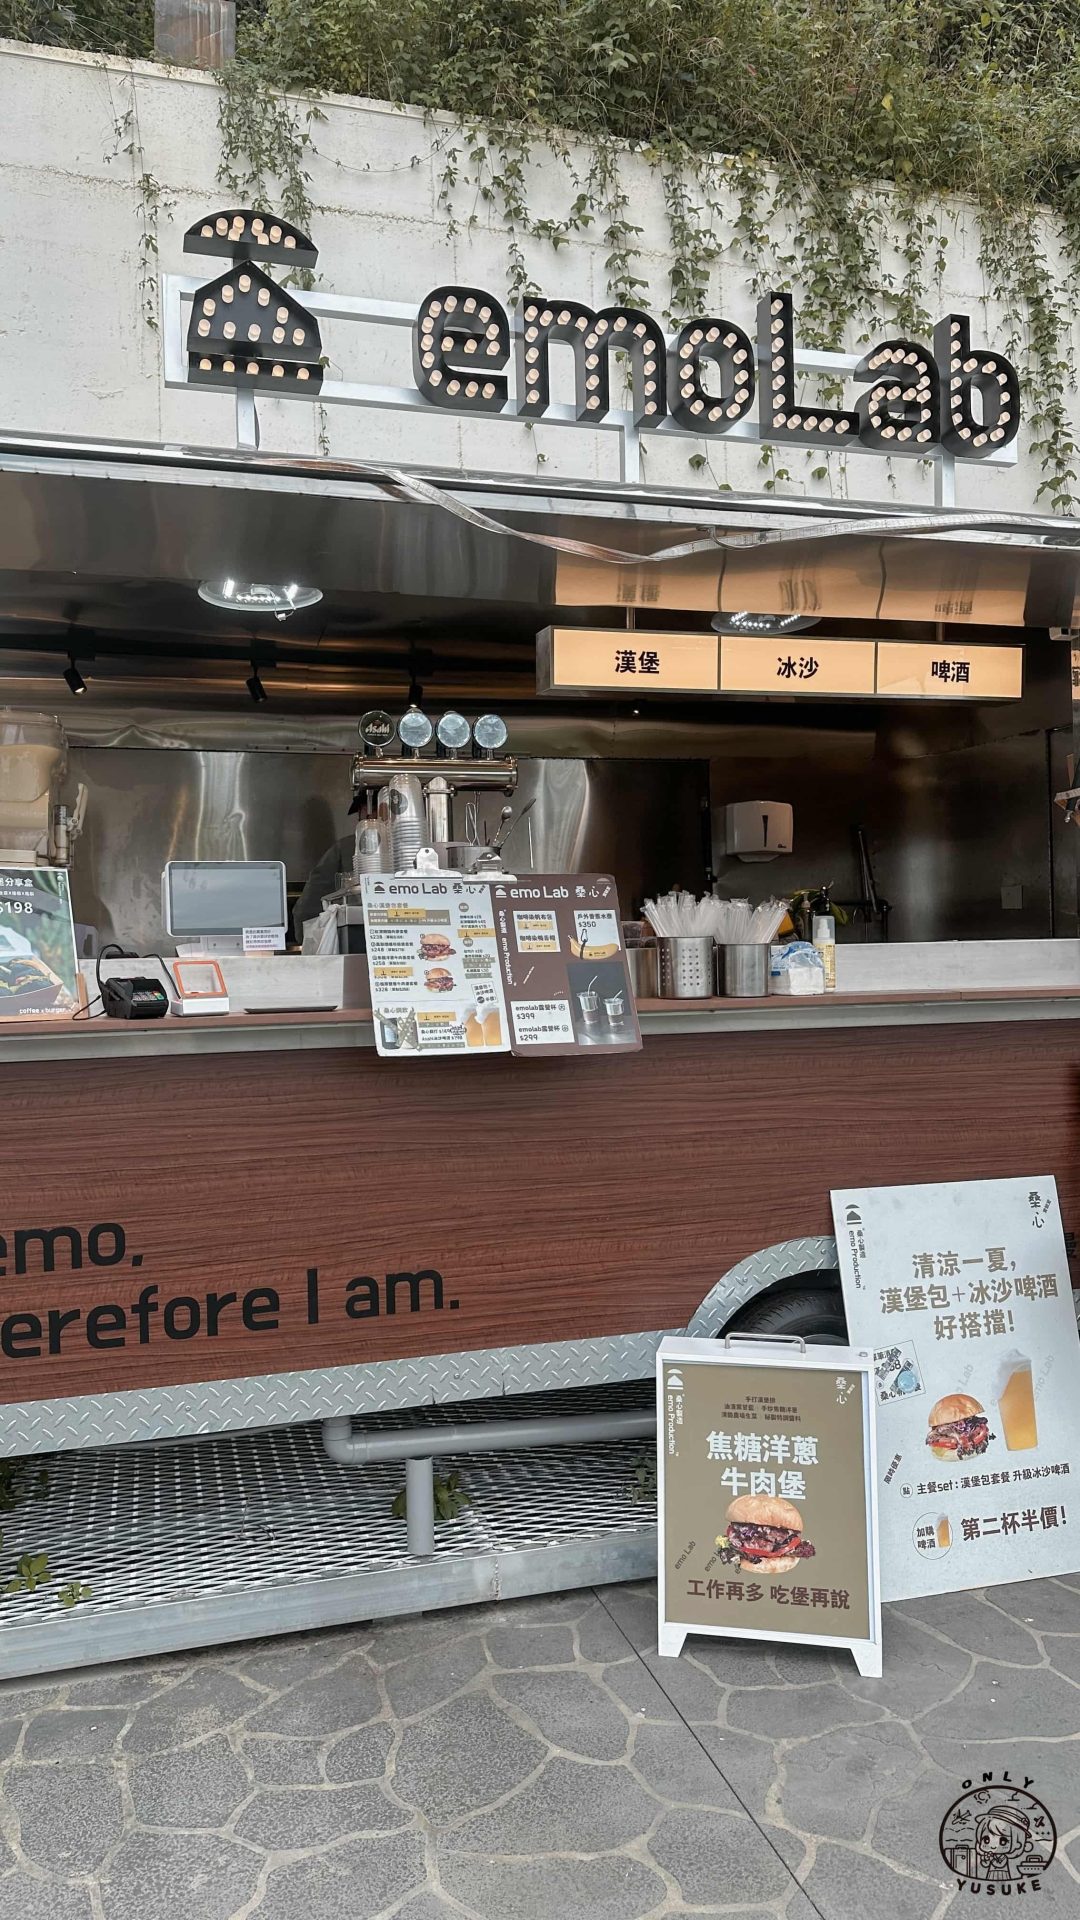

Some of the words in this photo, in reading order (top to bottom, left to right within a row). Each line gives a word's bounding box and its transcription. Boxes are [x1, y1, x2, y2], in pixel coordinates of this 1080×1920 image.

[615, 650, 660, 674] 漢堡
[776, 656, 819, 678] 冰沙
[931, 660, 970, 683] 啤酒
[389, 884, 419, 894] emo
[422, 883, 447, 894] Lab
[510, 888, 540, 898] emo
[543, 886, 569, 898] Lab
[0, 1222, 143, 1276] mo,
[912, 1247, 1016, 1279] 清涼一夏,
[851, 1249, 861, 1288] Production
[307, 1268, 319, 1324] I
[346, 1269, 460, 1319] am.
[668, 1414, 676, 1454] Production
[706, 1430, 818, 1465] 焦糖洋蔥
[720, 1466, 806, 1500] 牛肉堡
[1012, 1463, 1070, 1482] 升級冰沙啤酒
[916, 1526, 934, 1537] 加購
[961, 1506, 1067, 1542] 第二杯半價!
[675, 1553, 687, 1570] emo
[686, 1540, 696, 1555] Lab
[917, 1538, 936, 1550] 啤酒
[704, 1556, 716, 1572] emo
[687, 1579, 764, 1602] 工作再多
[770, 1584, 850, 1610] 吃堡再說
